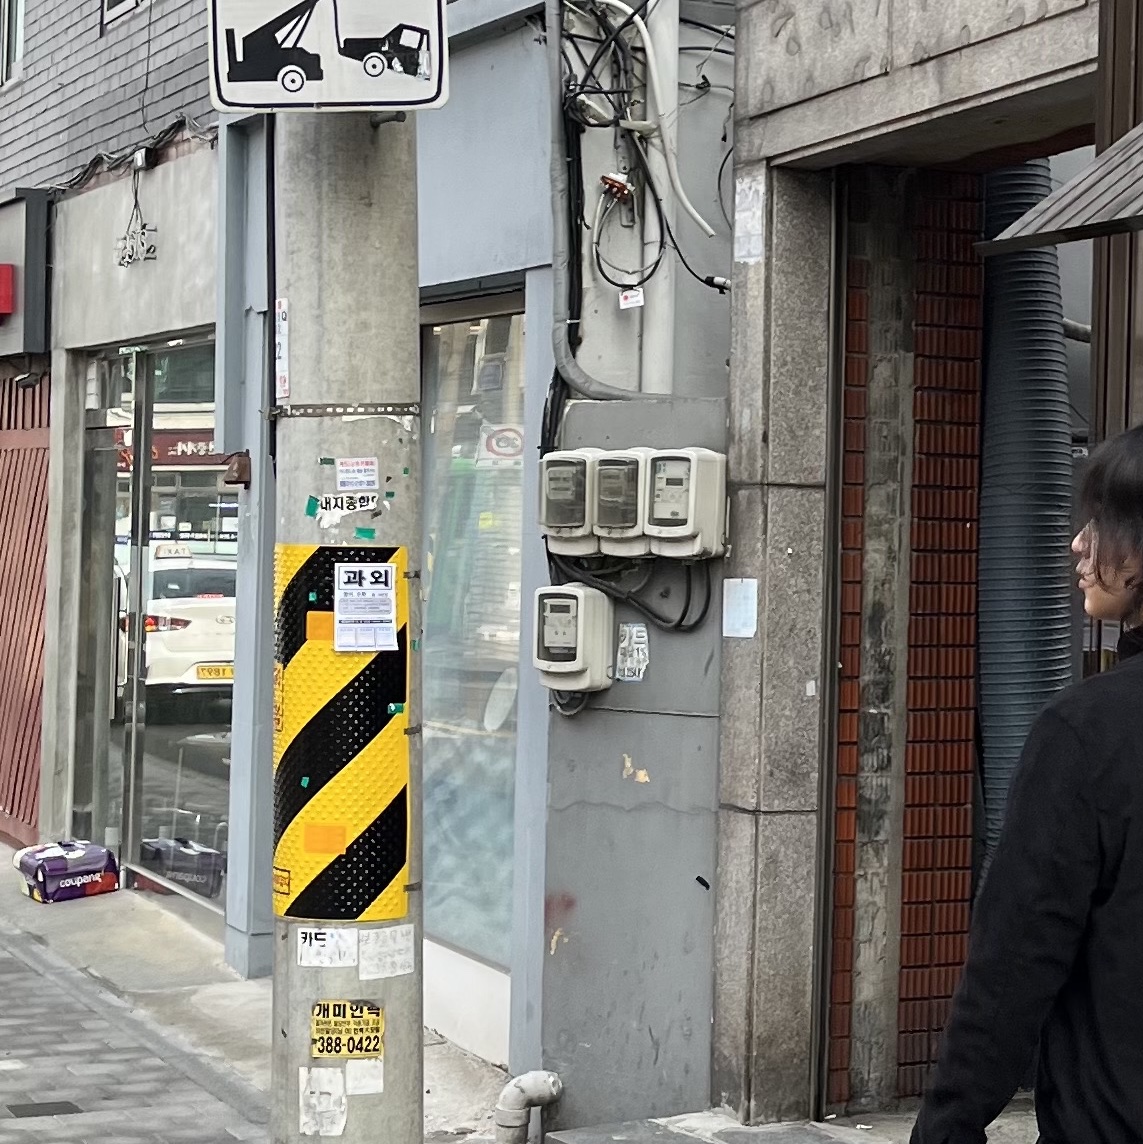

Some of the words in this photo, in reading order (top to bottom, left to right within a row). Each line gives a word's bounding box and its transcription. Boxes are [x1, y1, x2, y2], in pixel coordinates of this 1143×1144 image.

[343, 569, 390, 588] 과외
[60, 872, 102, 888] coupang
[317, 1035, 380, 1054] 388-0422
